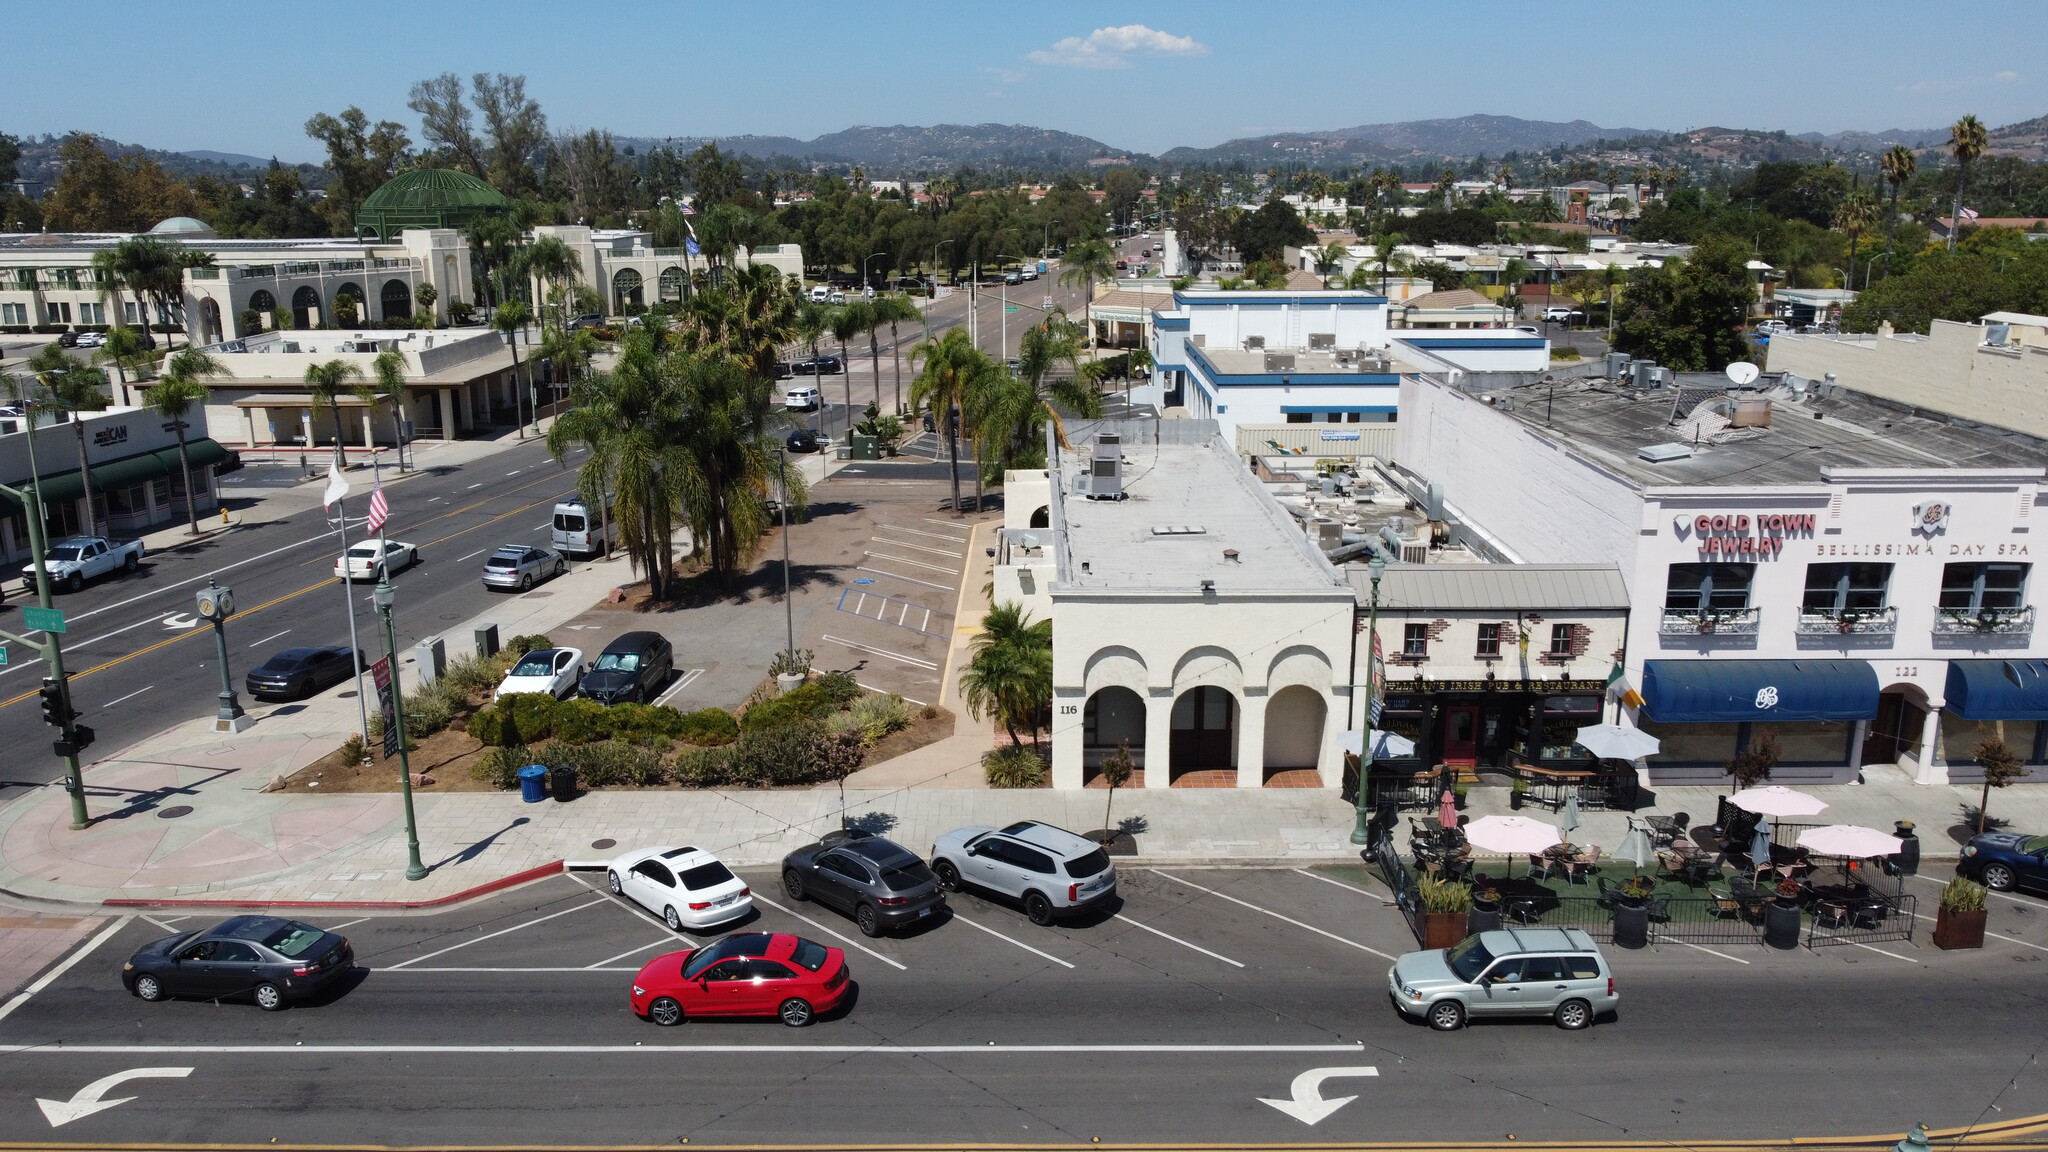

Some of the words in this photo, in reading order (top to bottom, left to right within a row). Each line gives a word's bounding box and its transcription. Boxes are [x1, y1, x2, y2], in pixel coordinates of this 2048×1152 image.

[1694, 514, 1751, 531] GOLD
[1757, 514, 1817, 531] TOWN
[1699, 537, 1784, 553] JEWELRY
[1817, 544, 1934, 556] BELLISSIMA
[1949, 544, 1985, 556] DAY
[1998, 544, 2029, 556] SPA
[1895, 666, 1917, 677] 122
[1387, 681, 1446, 691] ULLIVAN'S
[1450, 681, 1482, 691] IRISH
[1488, 681, 1509, 691] PUB
[1514, 681, 1523, 691] &
[1528, 681, 1602, 691] RESTAURANT
[1060, 704, 1078, 715] 116
